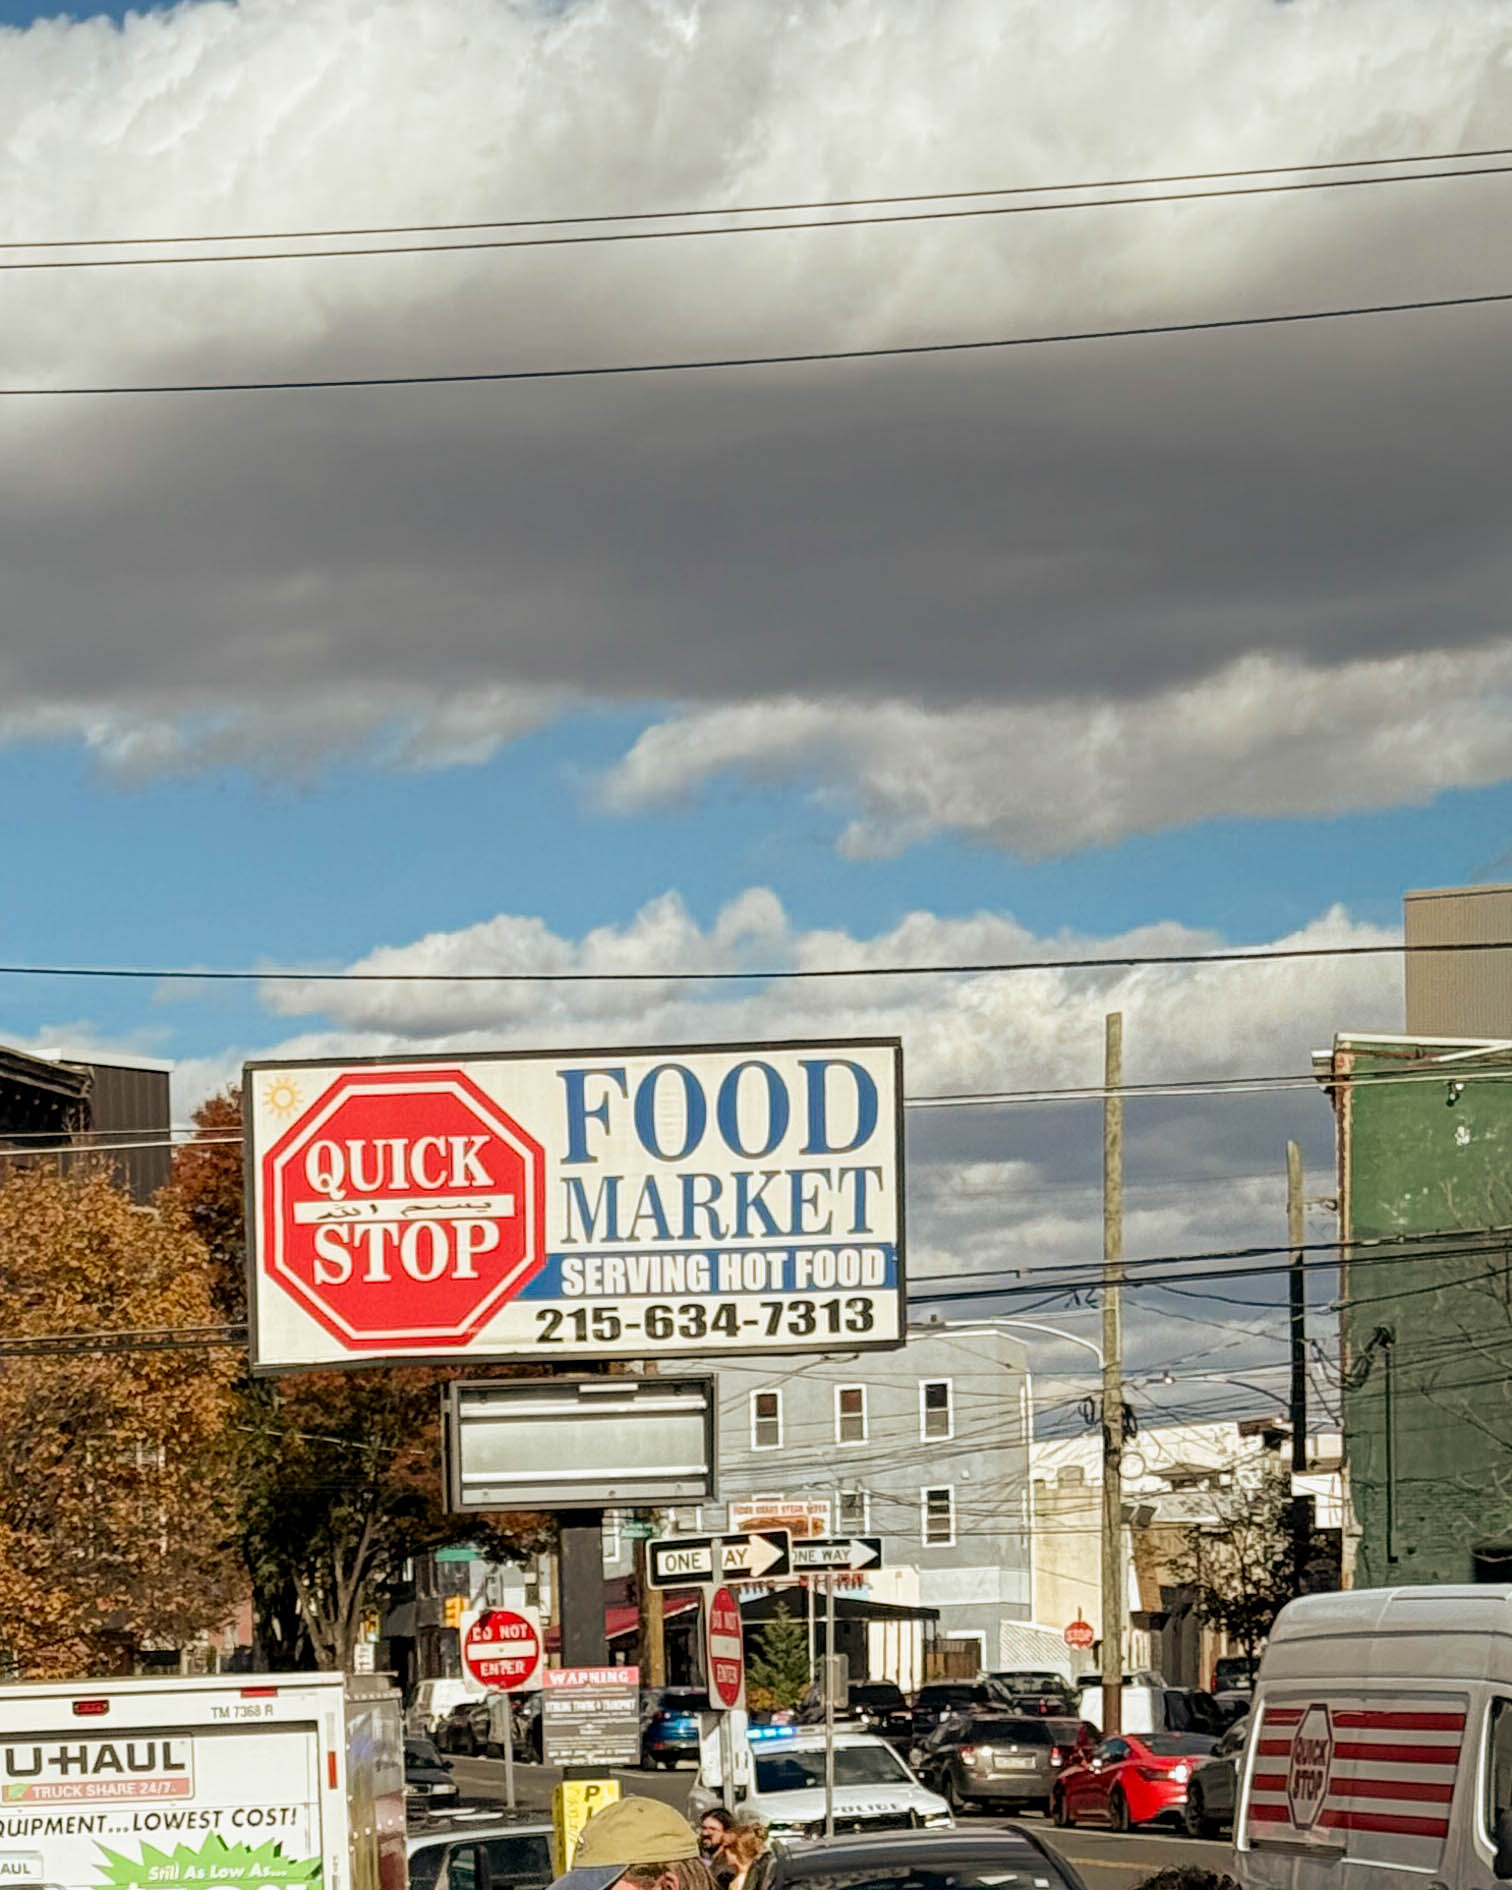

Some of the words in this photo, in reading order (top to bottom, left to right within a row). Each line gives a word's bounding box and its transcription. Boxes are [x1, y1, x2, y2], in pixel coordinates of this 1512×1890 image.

[557, 1059, 878, 1164] FOOD
[305, 1135, 494, 1200] QUICK
[560, 1166, 883, 1244] MARKET
[314, 1219, 499, 1285] STOP
[560, 1253, 711, 1297] SERVING
[718, 1250, 788, 1292] HOT
[796, 1248, 885, 1289] FOOD
[535, 1297, 874, 1344] 215-634-7313
[664, 1551, 703, 1572] ONE
[724, 1547, 748, 1567] AY
[823, 1549, 850, 1562] WAY
[472, 1626, 492, 1641] DO
[499, 1623, 528, 1640] NOT
[480, 1660, 526, 1677] ENTER
[549, 1670, 629, 1685] WARNING
[210, 1706, 230, 1720] TM
[5, 1741, 185, 1777] U-HAUL
[1295, 1736, 1328, 1766] QUICK
[32, 1784, 83, 1799] TRUCK
[86, 1783, 137, 1798] SHARE
[140, 1781, 171, 1796] 24/7
[1293, 1769, 1324, 1801] STOP
[231, 1807, 297, 1827] COST!
[147, 1862, 179, 1881] Still
[184, 1865, 205, 1880] As
[210, 1864, 244, 1879] Low
